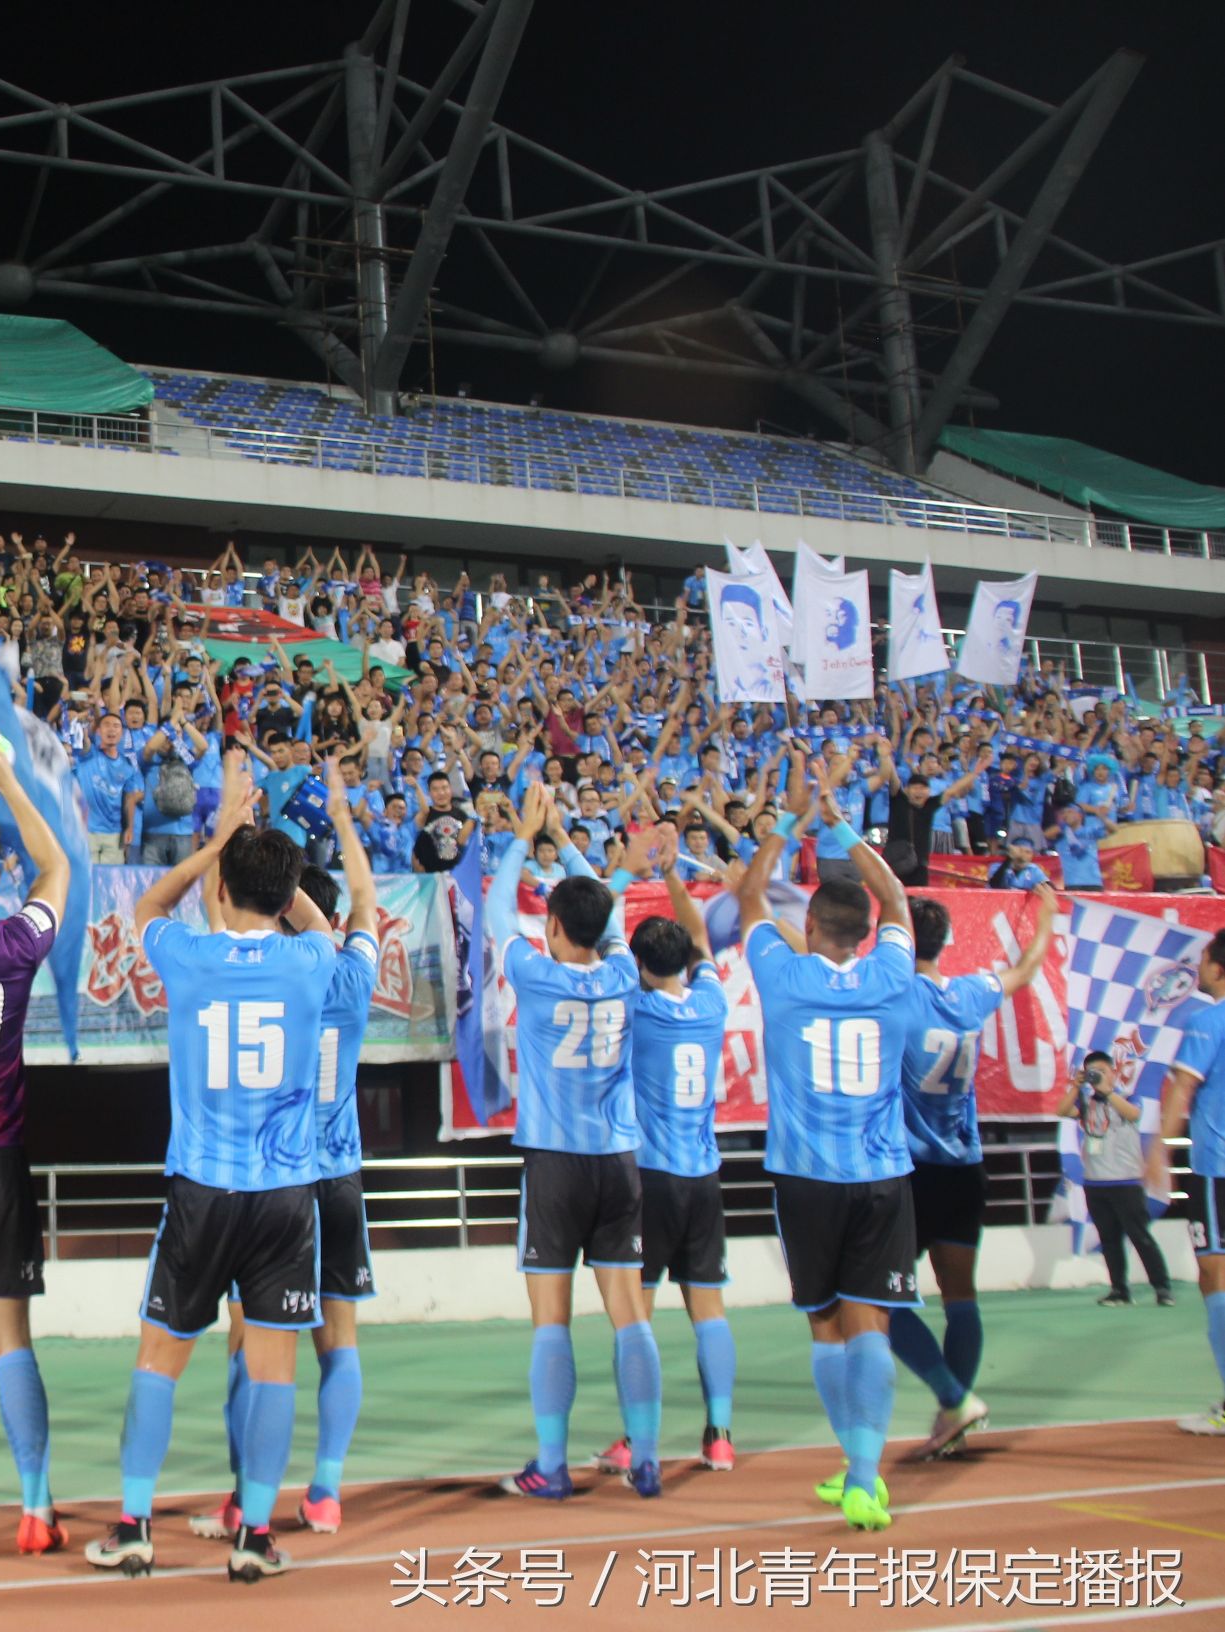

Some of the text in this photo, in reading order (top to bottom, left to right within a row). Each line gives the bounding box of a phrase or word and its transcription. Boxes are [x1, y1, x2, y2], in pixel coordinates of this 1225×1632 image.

[198, 1000, 285, 1089] 15
[552, 1000, 626, 1069] 28
[802, 1017, 880, 1097] 10
[920, 1028, 981, 1095] 24
[674, 1042, 706, 1108] 8
